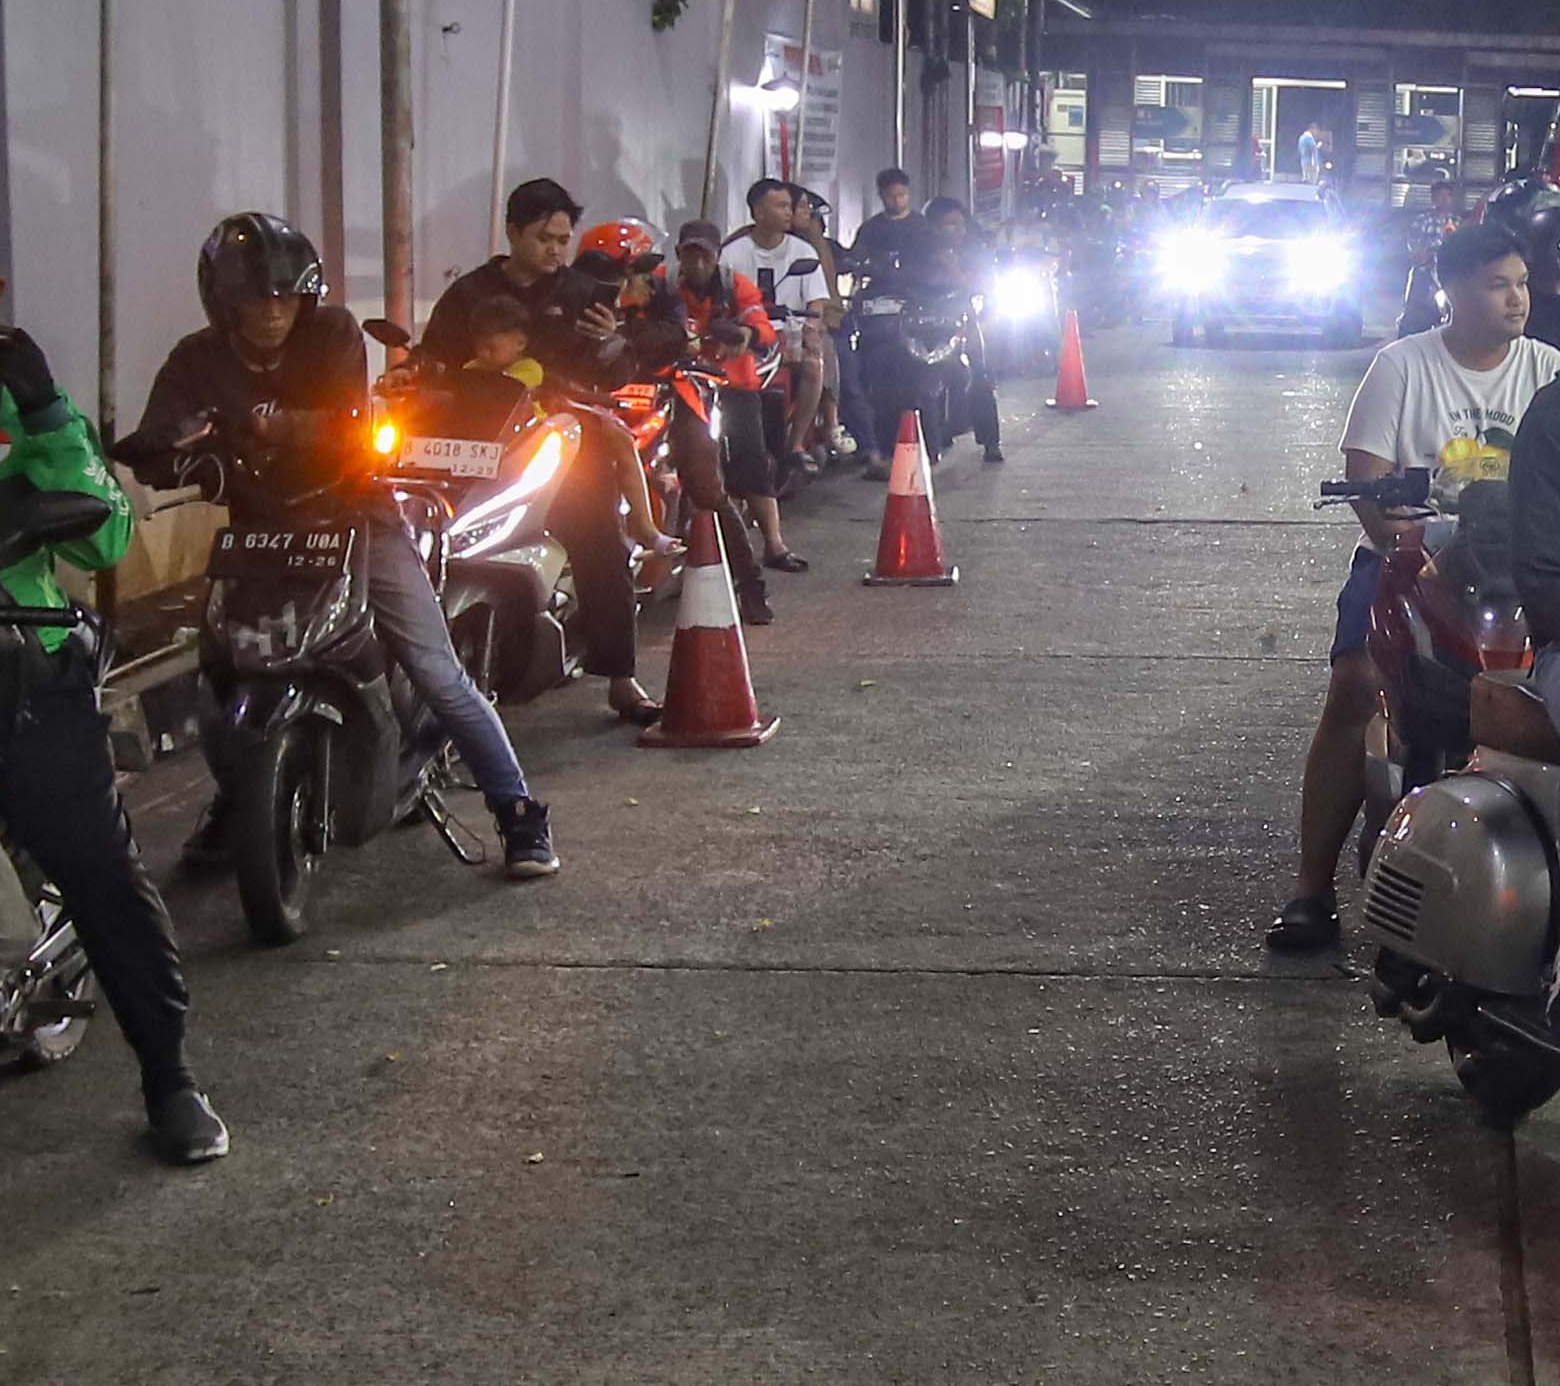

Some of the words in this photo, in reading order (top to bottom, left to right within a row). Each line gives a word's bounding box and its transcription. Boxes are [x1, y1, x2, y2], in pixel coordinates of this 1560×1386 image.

[1463, 406, 1481, 420] THE
[221, 533, 234, 551] B
[244, 533, 294, 551] 6347
